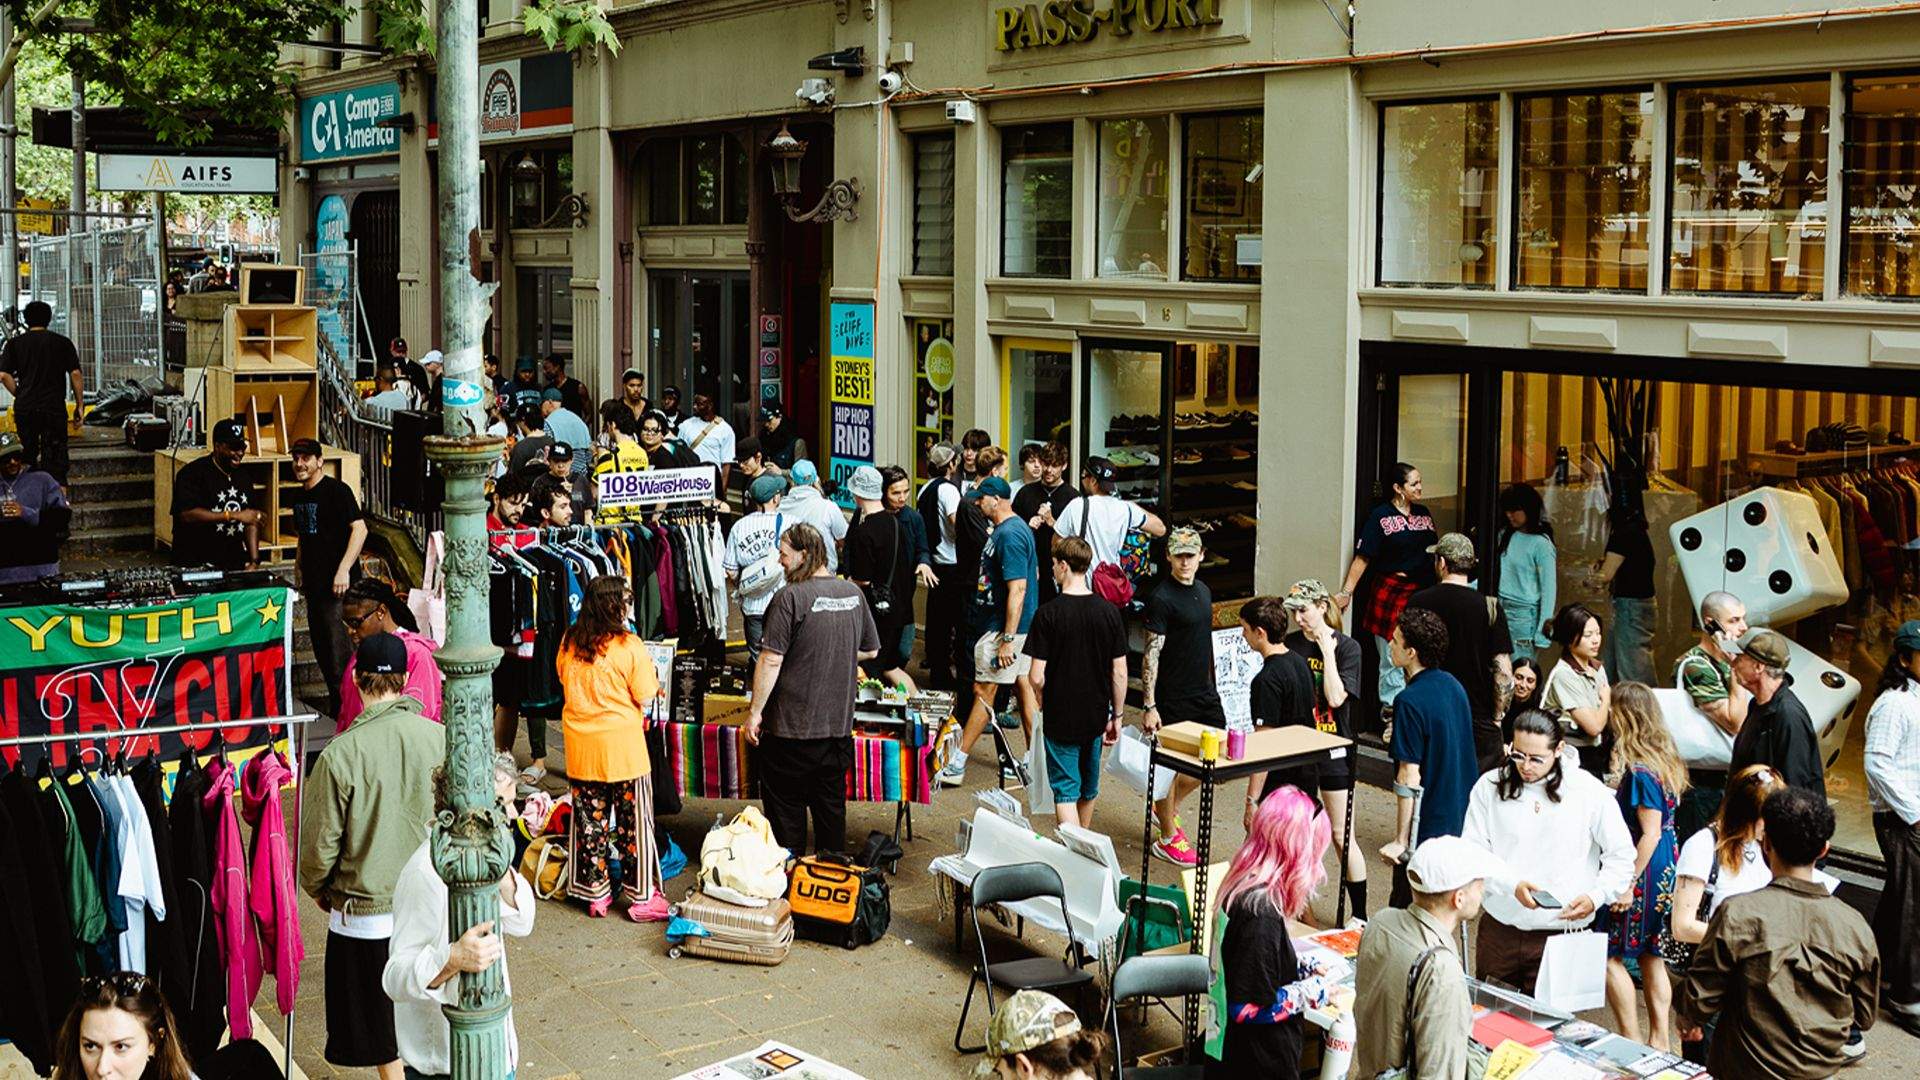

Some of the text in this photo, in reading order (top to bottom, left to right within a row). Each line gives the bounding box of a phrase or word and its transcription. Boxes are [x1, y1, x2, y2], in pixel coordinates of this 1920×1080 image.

[345, 93, 380, 125] Camp
[311, 99, 341, 153] CA
[344, 123, 394, 149] America
[181, 166, 232, 181] AIFS
[840, 318, 861, 336] CLIFF
[845, 332, 864, 351] DIVE
[835, 360, 870, 376] SYDNEY'S
[835, 375, 870, 399] BEST!
[834, 405, 851, 423] HIP
[834, 423, 871, 457] RNB
[601, 475, 638, 494] 108
[7, 601, 233, 651] YUTH
[35, 667, 161, 768] THE
[174, 646, 284, 751] CUT
[797, 881, 851, 904] UDG
